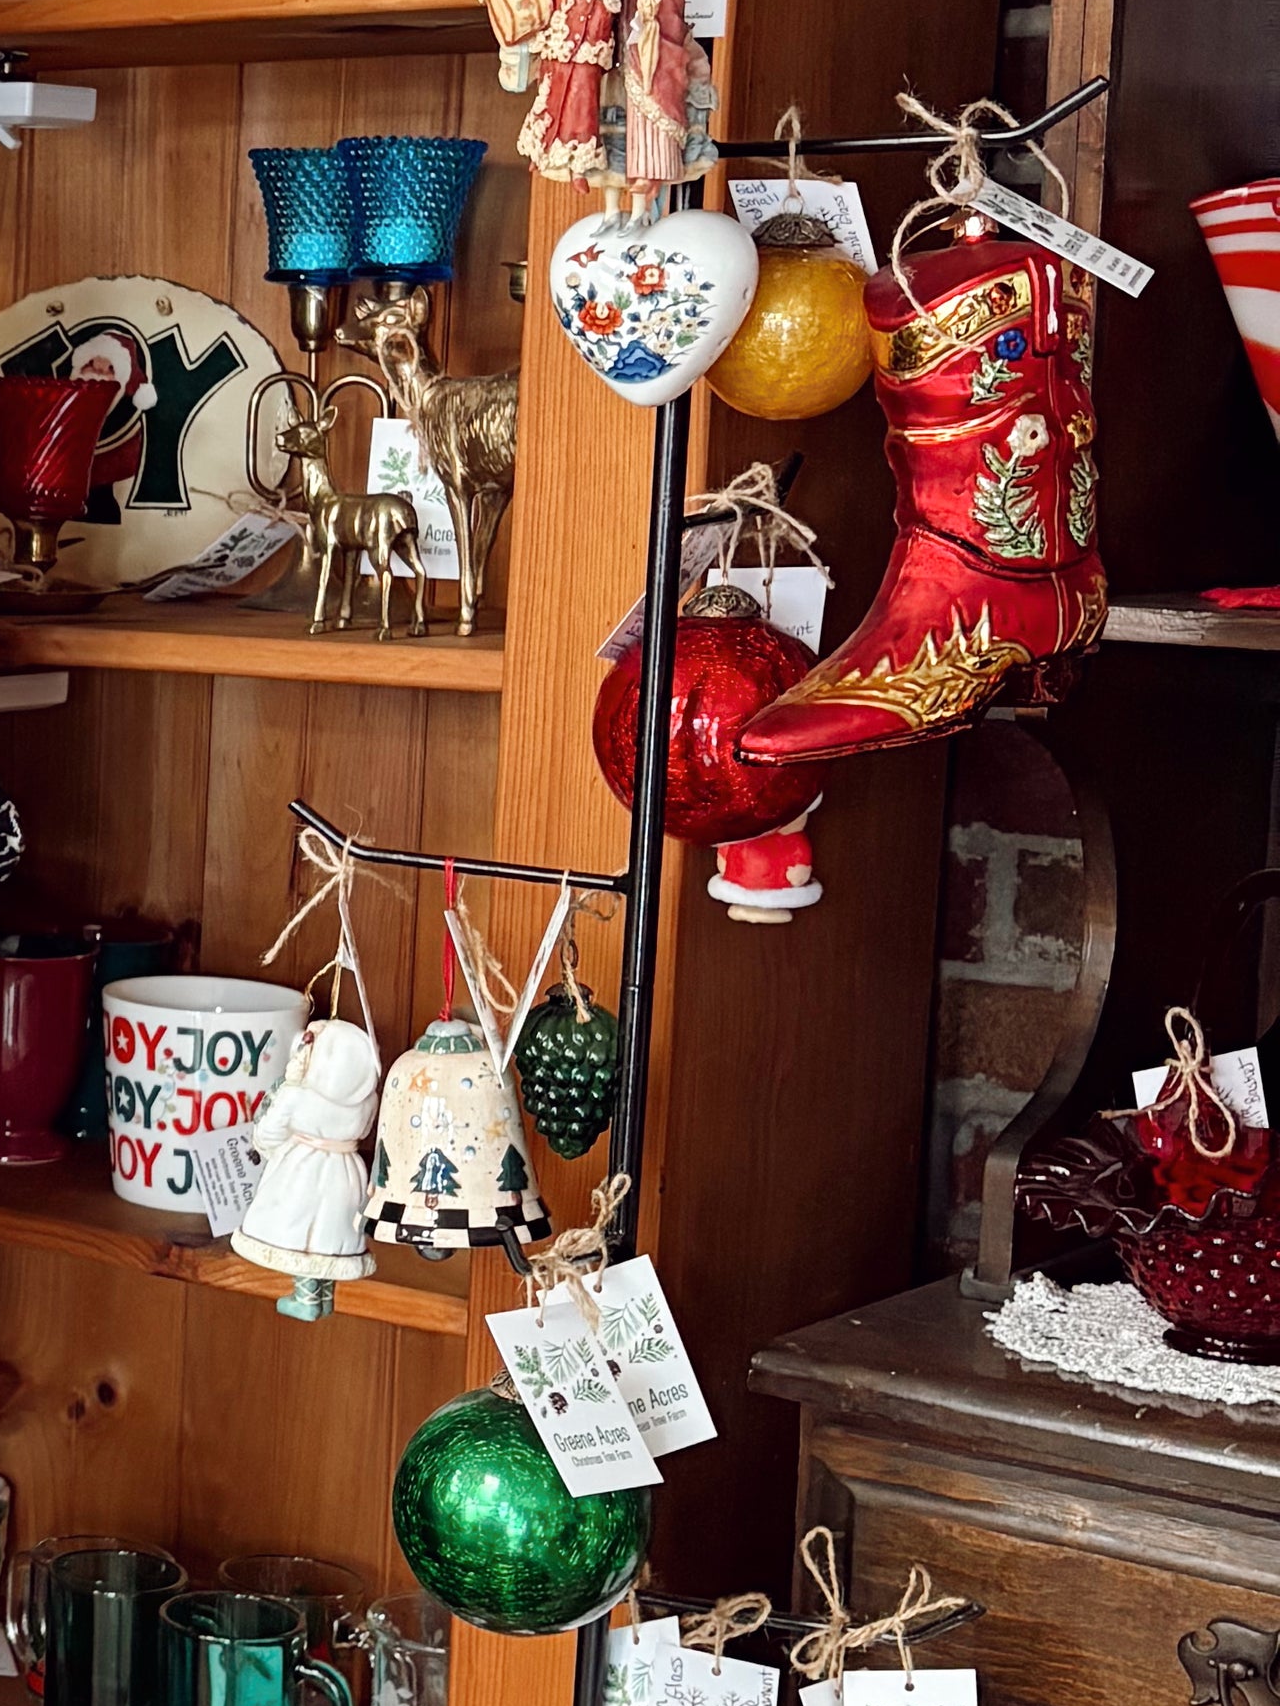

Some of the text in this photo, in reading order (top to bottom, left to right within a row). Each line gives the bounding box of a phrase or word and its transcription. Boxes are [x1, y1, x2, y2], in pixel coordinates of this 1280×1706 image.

[424, 523, 457, 542] Acre
[172, 1026, 274, 1077] JOY
[172, 1087, 267, 1136] JOY
[226, 1137, 246, 1179] Greene
[648, 1383, 689, 1410] Acres
[553, 1425, 631, 1453] Greene Acres
